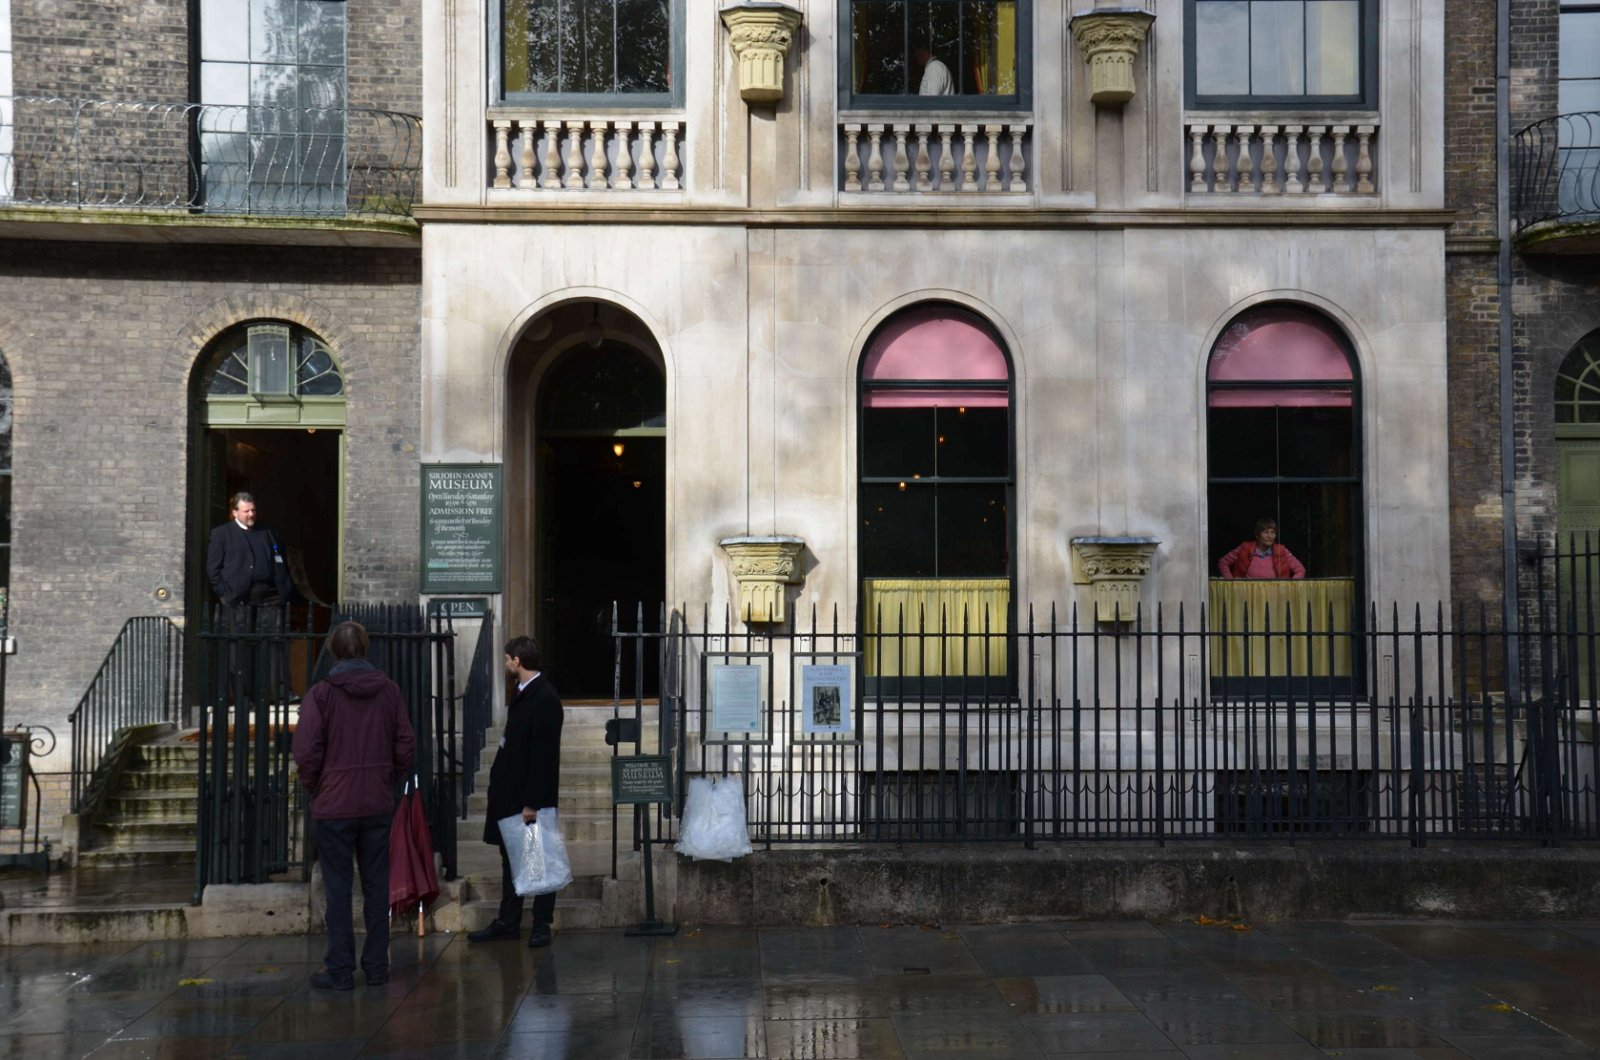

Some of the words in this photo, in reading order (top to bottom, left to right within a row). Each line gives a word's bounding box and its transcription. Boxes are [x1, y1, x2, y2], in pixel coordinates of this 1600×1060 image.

[429, 480, 493, 489] MUSEUM
[441, 601, 475, 612] OPEN
[621, 771, 664, 779] MUSEUM
